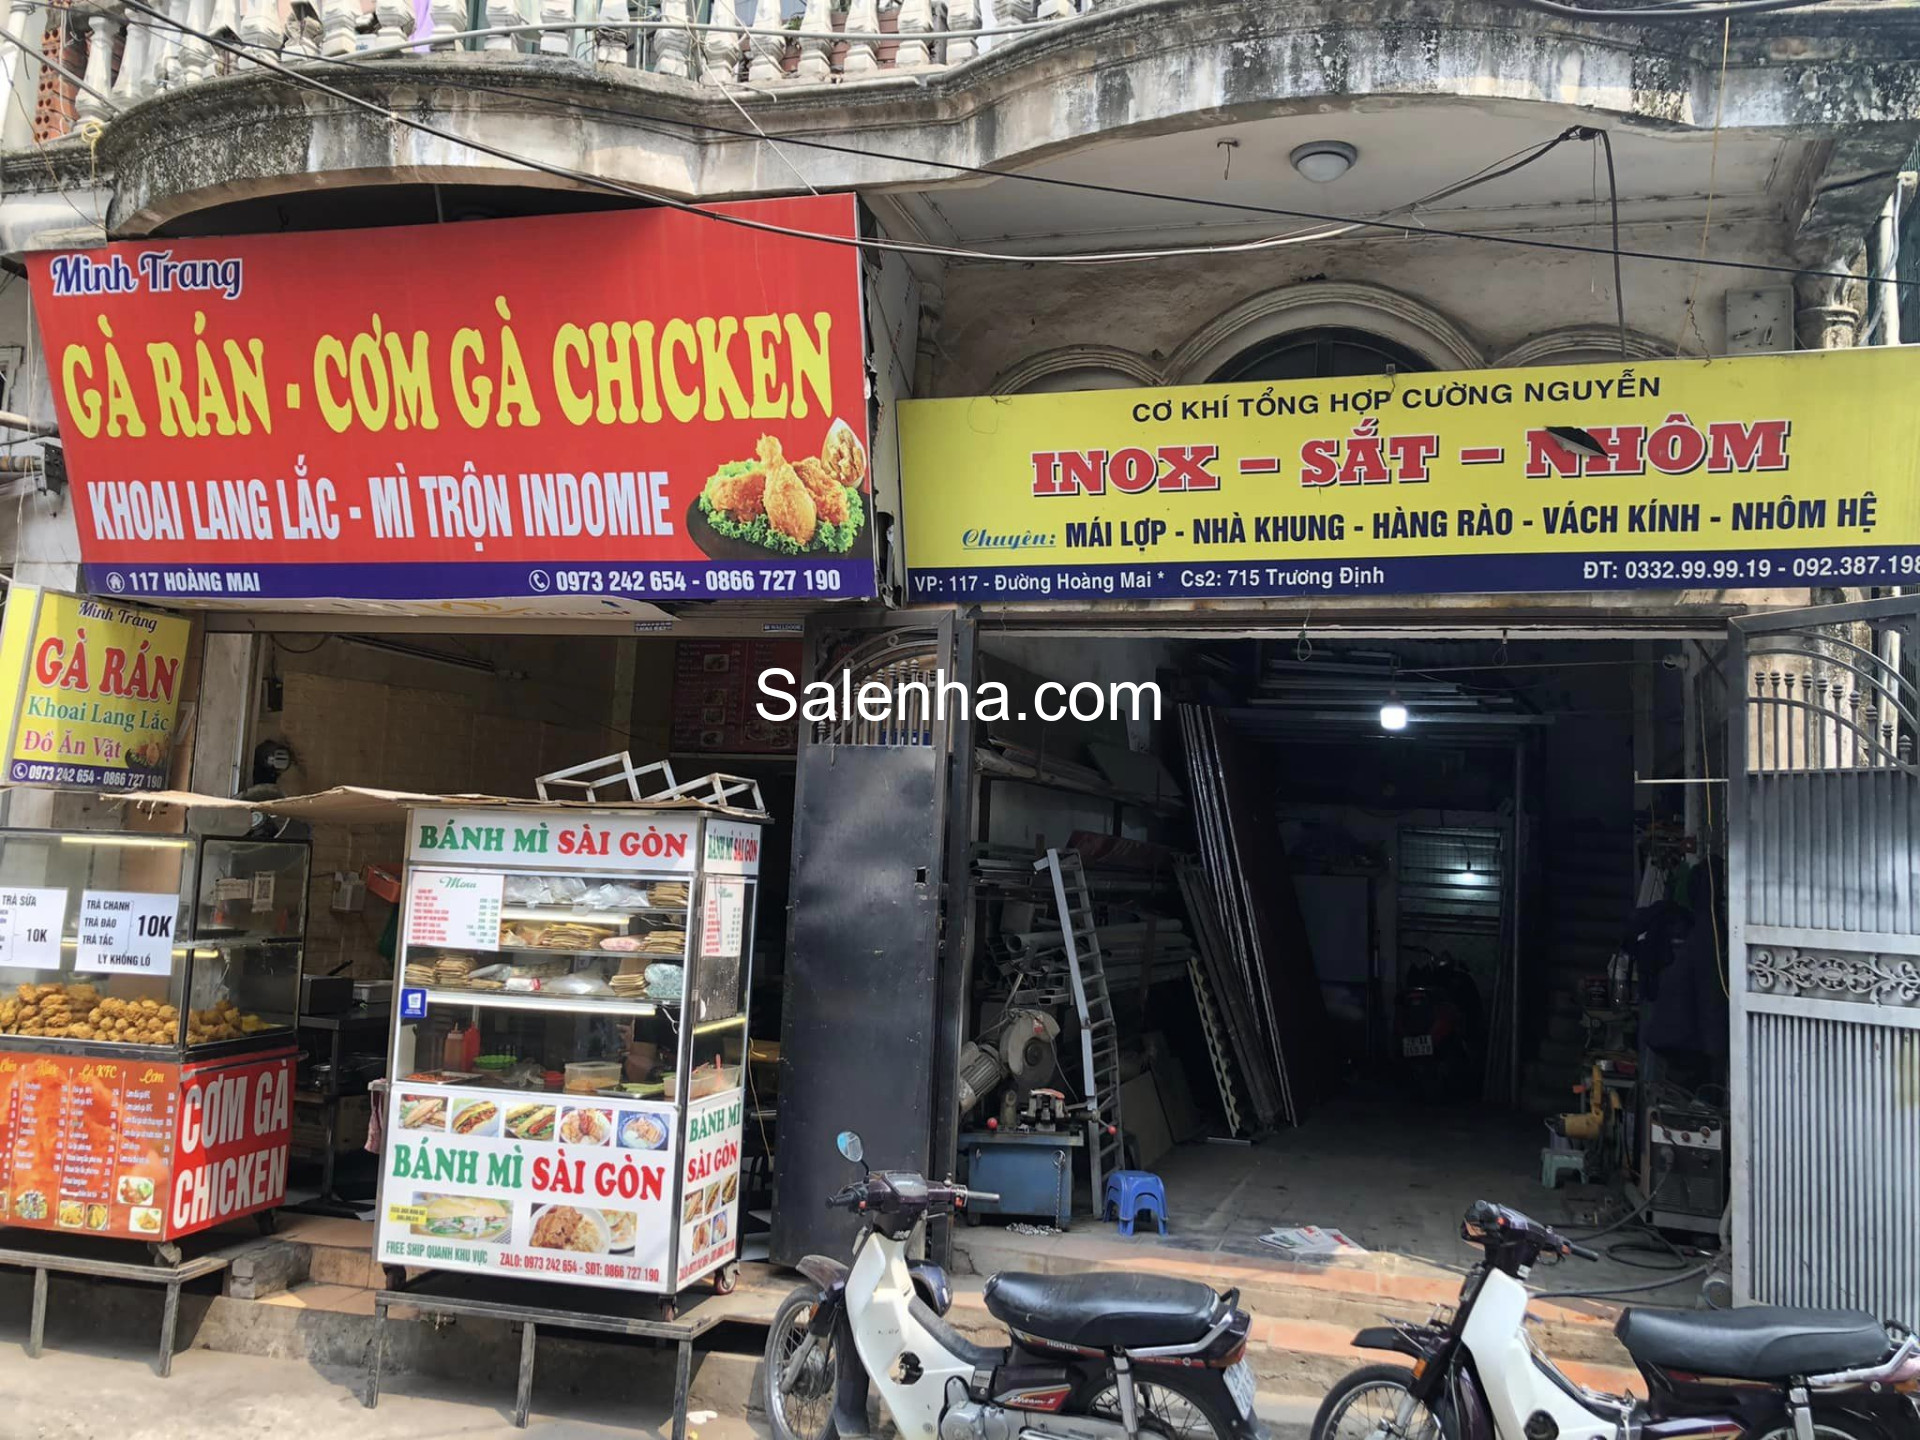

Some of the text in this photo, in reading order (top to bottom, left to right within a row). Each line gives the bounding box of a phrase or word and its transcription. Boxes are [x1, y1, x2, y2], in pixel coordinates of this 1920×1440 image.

[52, 249, 243, 299] Minh Trang
[62, 314, 146, 439] GÀ
[147, 311, 271, 437] RÁN
[286, 383, 300, 408] -
[313, 313, 439, 433] CƠM
[450, 296, 540, 428] GÀ
[553, 312, 832, 426] CHICKEN
[1132, 368, 1661, 422] CƠ KHÍ TỔNG HỢP CƯỜNG NGUYỄN
[1031, 444, 1219, 497] INOX
[1300, 419, 1439, 488] SẮT
[1525, 413, 1791, 478] NHÔM
[87, 455, 673, 551] KHOAI LANG LẮC - MÌ TRỘN INDOMIE
[961, 528, 1056, 550] Chuyên:
[1066, 516, 1112, 548] MÁI
[1120, 517, 1167, 553] LỢP
[1193, 512, 1246, 545] NHÀ
[1254, 514, 1345, 544] KHUNG
[1373, 506, 1448, 540] HÀNG
[1457, 502, 1513, 536] RÀO
[1543, 501, 1618, 535] VÁCH
[1628, 498, 1700, 534] KÍNH
[1732, 496, 1826, 530] NHÔM
[1838, 491, 1877, 534] HỆ
[129, 567, 260, 592] 117 HOÀNG MAI
[556, 572, 604, 592] 0973
[609, 571, 645, 592] 242
[650, 571, 687, 591] 654
[706, 570, 754, 591] 0866
[759, 570, 796, 591] 727
[804, 569, 841, 591] 190
[914, 575, 943, 593] VP:
[949, 575, 977, 593] 117
[994, 571, 1051, 595] Đường
[1057, 569, 1114, 595] Hoàng
[1119, 570, 1152, 590] Mai
[1180, 569, 1222, 589] Cs2:
[1227, 570, 1260, 588] 715
[1265, 567, 1334, 591] Trương
[1339, 566, 1385, 589] Định
[1583, 562, 1618, 580] ĐT:
[1625, 559, 1771, 580] 0332.99.99.19
[79, 601, 158, 633] Minh Trang
[36, 628, 179, 703] GÀ RÁN
[27, 695, 169, 732] Khoai Lang Lắc
[24, 730, 53, 752] Đồ
[58, 730, 86, 756] Ăn
[29, 766, 54, 781] 0973
[56, 767, 74, 783] 242
[76, 768, 94, 783] 654
[103, 771, 126, 787] 0866
[128, 772, 145, 788] 727
[147, 774, 162, 789] 190
[419, 819, 689, 859] BÁNH MÌ SÀI GÒN
[103, 900, 130, 912] CHANH
[27, 928, 48, 943] 10K
[138, 914, 173, 938] 10K
[97, 953, 108, 965] LY
[181, 1073, 248, 1154] CƠM
[253, 1060, 289, 1137] GÀ
[689, 1096, 741, 1143] BÁNH MÌ
[392, 1137, 666, 1202] BÁNH MÌ SÀI GÒN
[687, 1139, 738, 1183] SÀI GÒN
[172, 1144, 288, 1230] CHICKEN
[386, 1240, 405, 1255] FREE
[406, 1242, 425, 1257] SHIP
[454, 1248, 471, 1262] KHU
[499, 1252, 522, 1267] ZALO:
[524, 1255, 544, 1270] 0973
[546, 1257, 560, 1271] 242
[604, 1264, 624, 1279] 0866
[626, 1265, 642, 1281] 727
[644, 1267, 659, 1283] 190
[1047, 1339, 1078, 1352] HONDA
